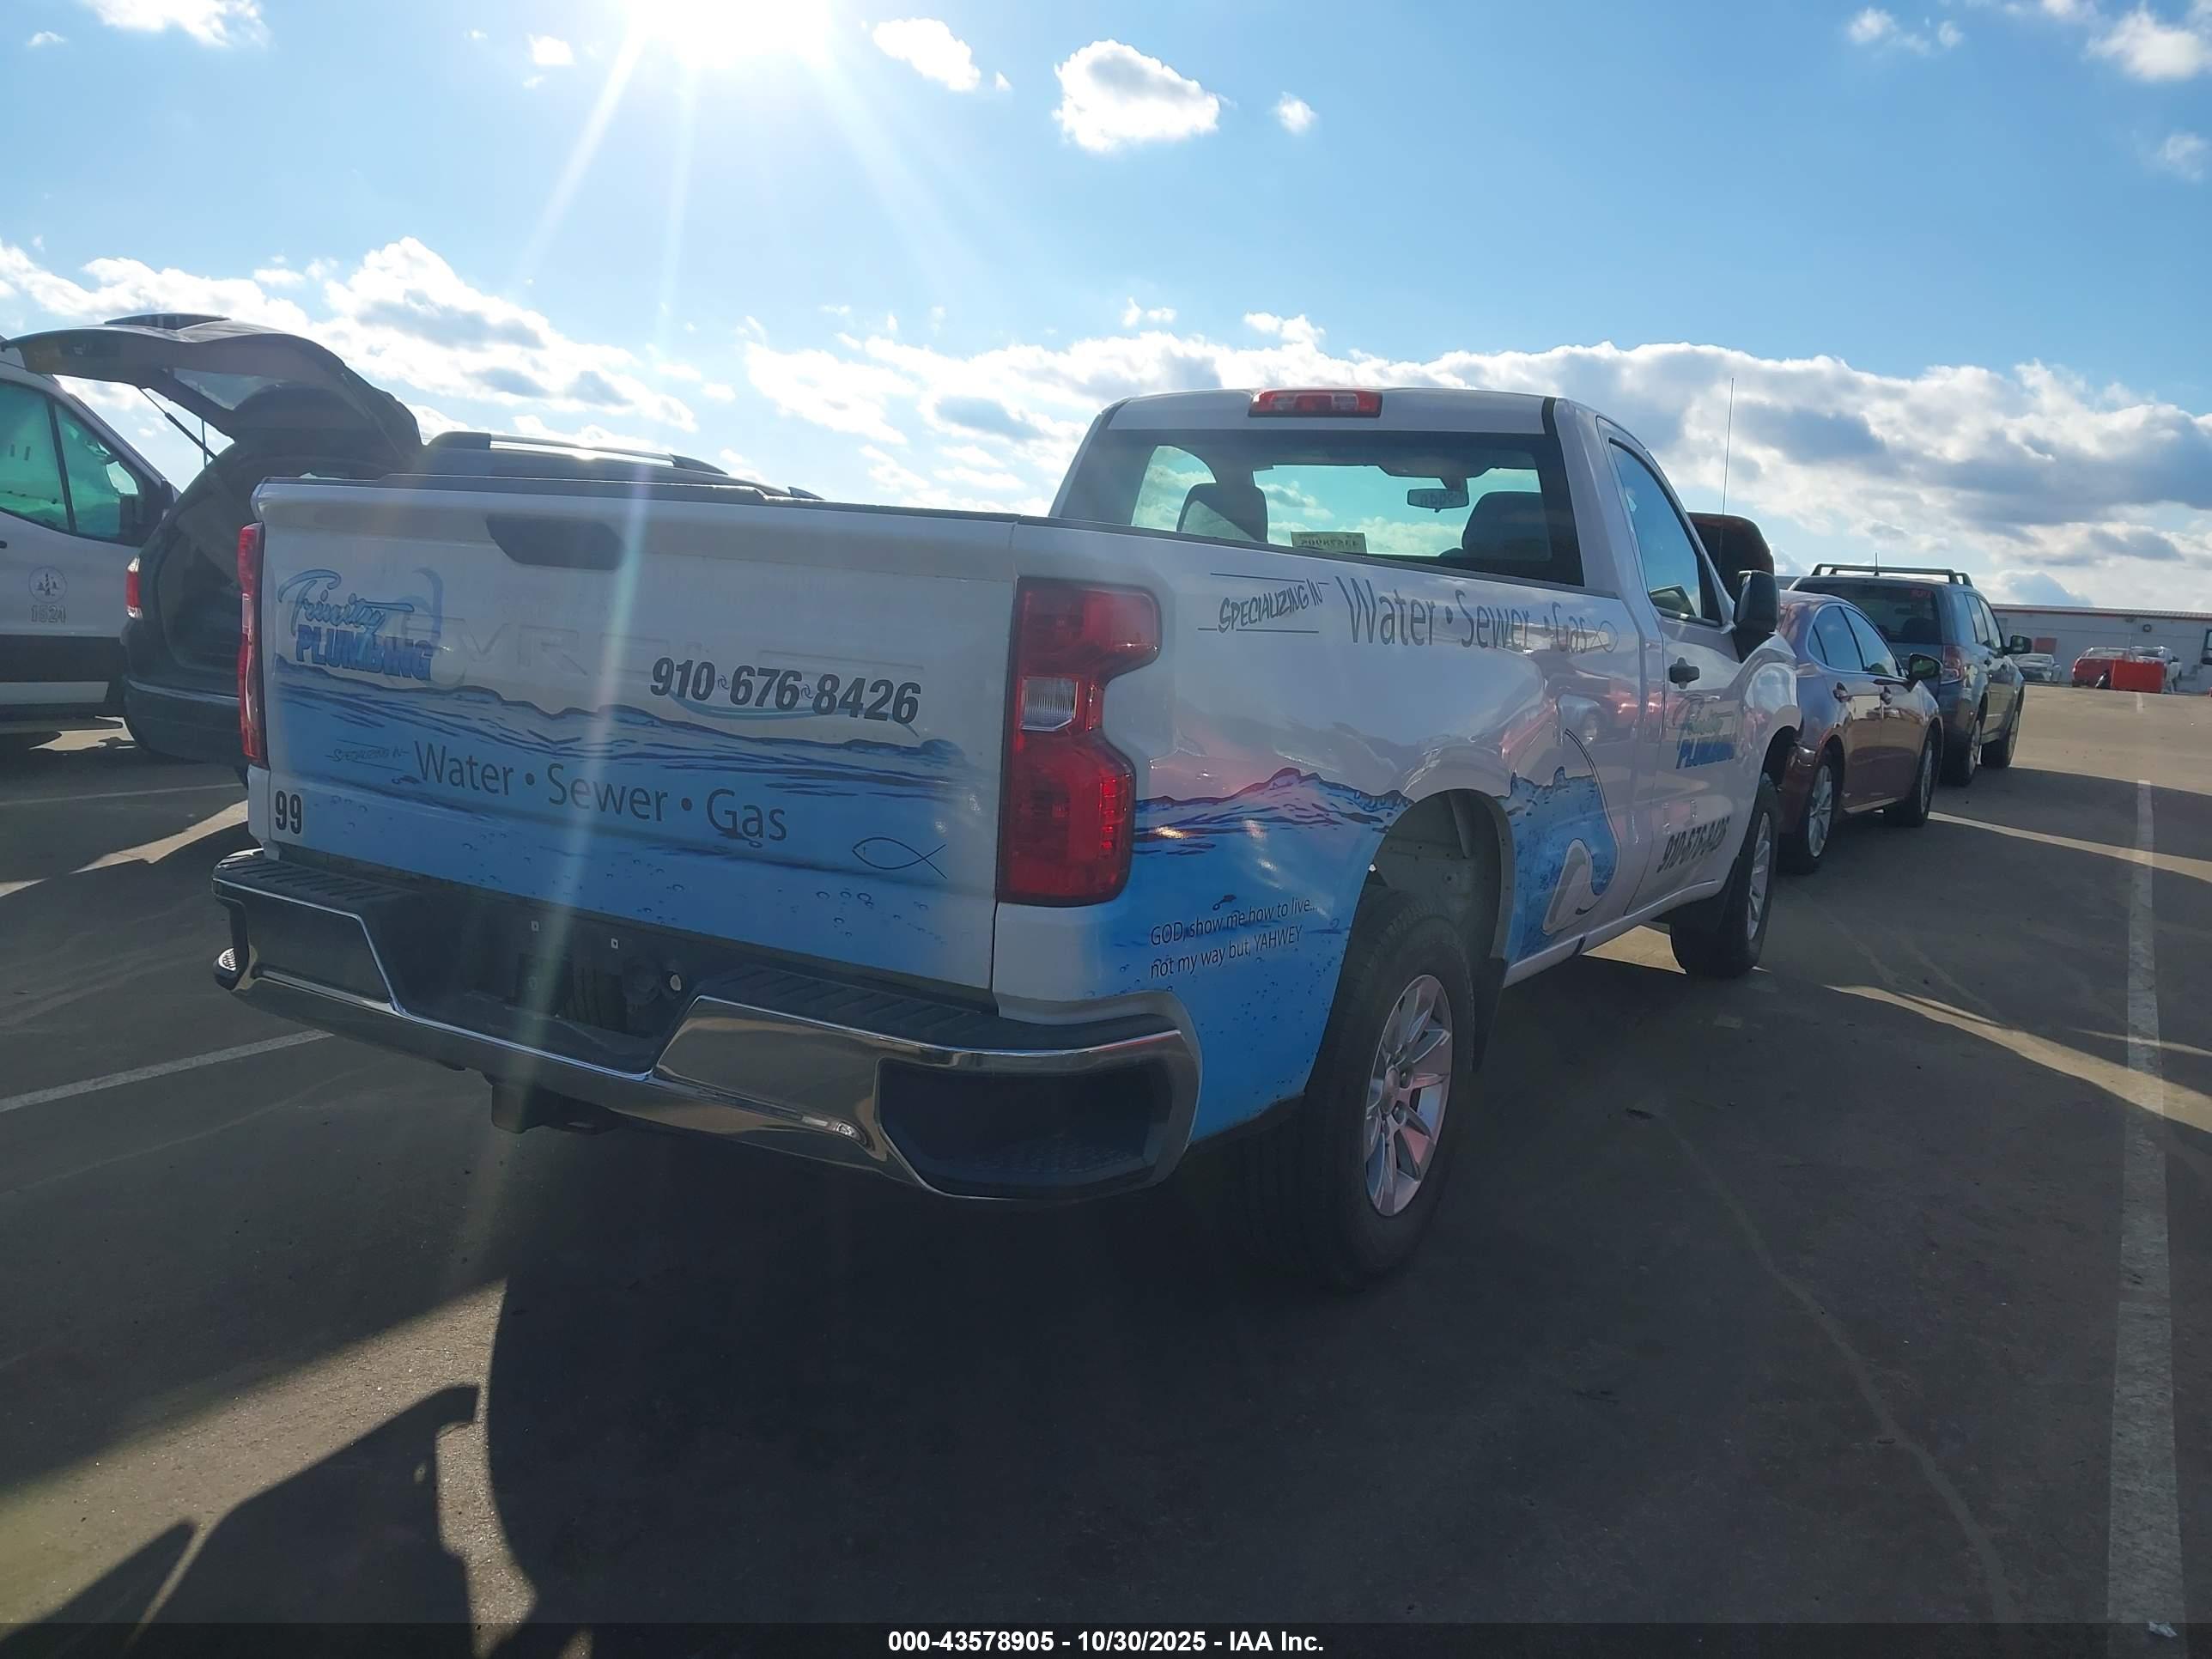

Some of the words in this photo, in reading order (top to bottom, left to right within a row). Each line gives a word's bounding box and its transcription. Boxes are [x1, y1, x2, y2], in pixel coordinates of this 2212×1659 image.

[277, 568, 415, 638] Trinity
[1218, 584, 1310, 634] SPECIALIZING
[1306, 578, 1323, 606] IN
[1334, 575, 1437, 646] Water
[1455, 589, 1530, 648] Sewer
[1551, 601, 1587, 653] Gas
[295, 623, 434, 681] PLUMBING
[649, 657, 717, 701] 910
[730, 665, 803, 711] 676
[811, 673, 922, 725] 8426
[274, 790, 303, 834] 99
[414, 740, 514, 796] Water
[546, 763, 668, 822] Sewer
[706, 787, 787, 842] Gas
[1188, 916, 1224, 939] show
[1226, 911, 1246, 928] me
[1249, 906, 1274, 924] how
[1276, 901, 1289, 918] to
[1150, 959, 1175, 979] not
[1177, 953, 1198, 975] my
[1200, 947, 1227, 968] way
[1253, 925, 1304, 951] YAHWEY
